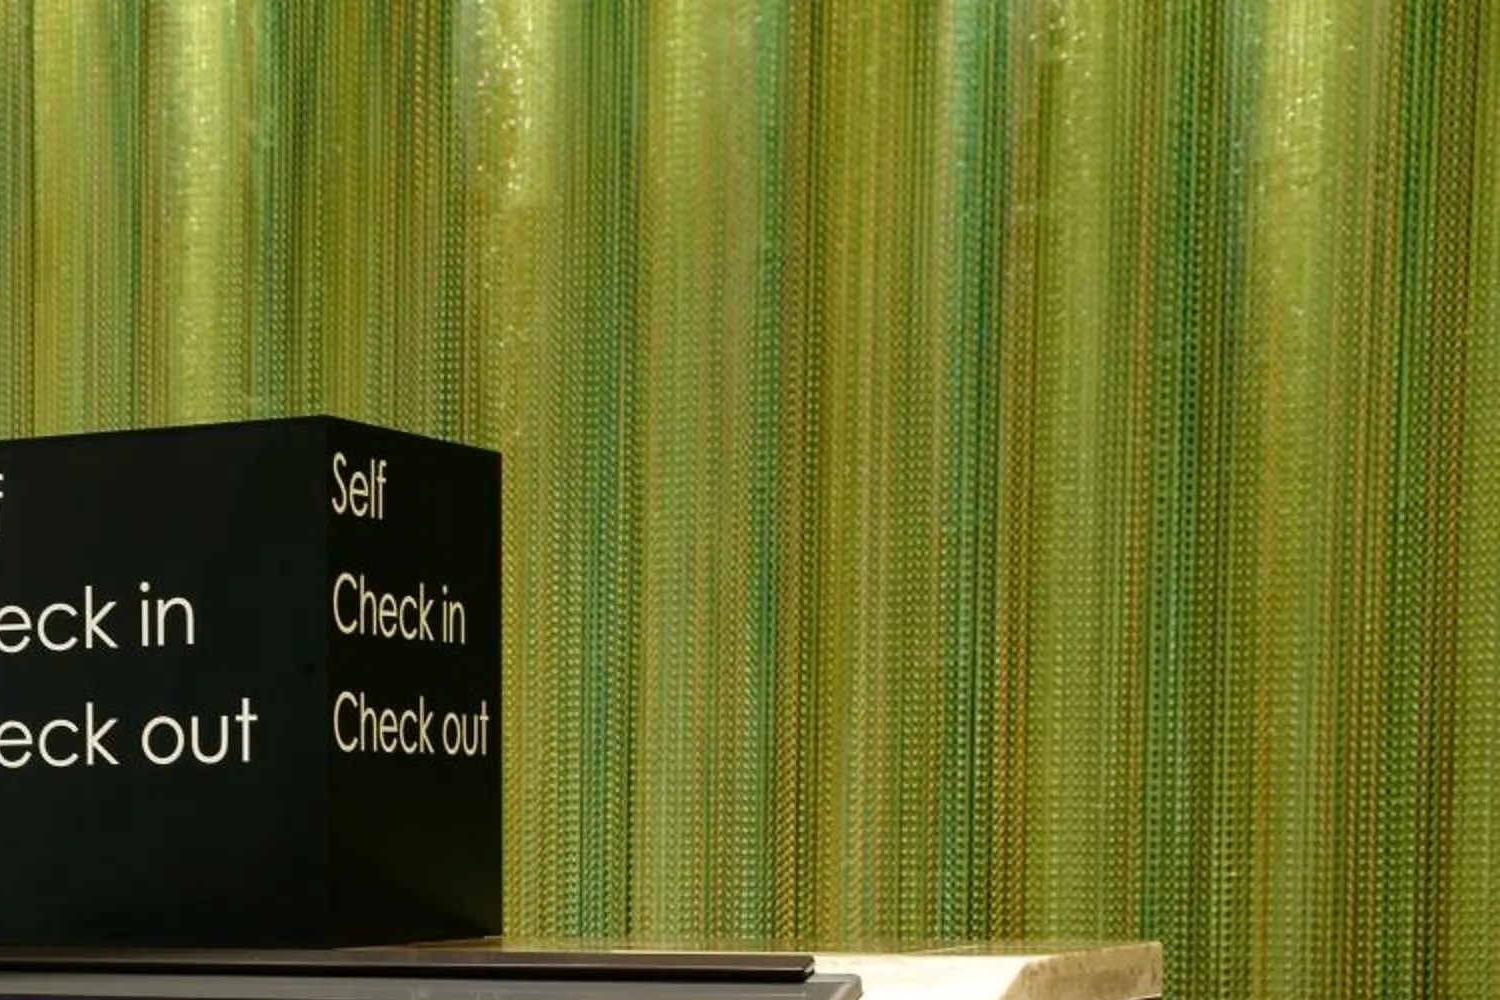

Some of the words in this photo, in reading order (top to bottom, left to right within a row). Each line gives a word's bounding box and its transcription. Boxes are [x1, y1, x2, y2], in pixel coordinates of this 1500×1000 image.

[331, 452, 388, 520] Self
[139, 581, 196, 648] in
[333, 571, 435, 642] Check
[441, 584, 467, 645] in
[141, 697, 259, 765] out
[333, 690, 435, 755] Check
[442, 700, 491, 757] out
